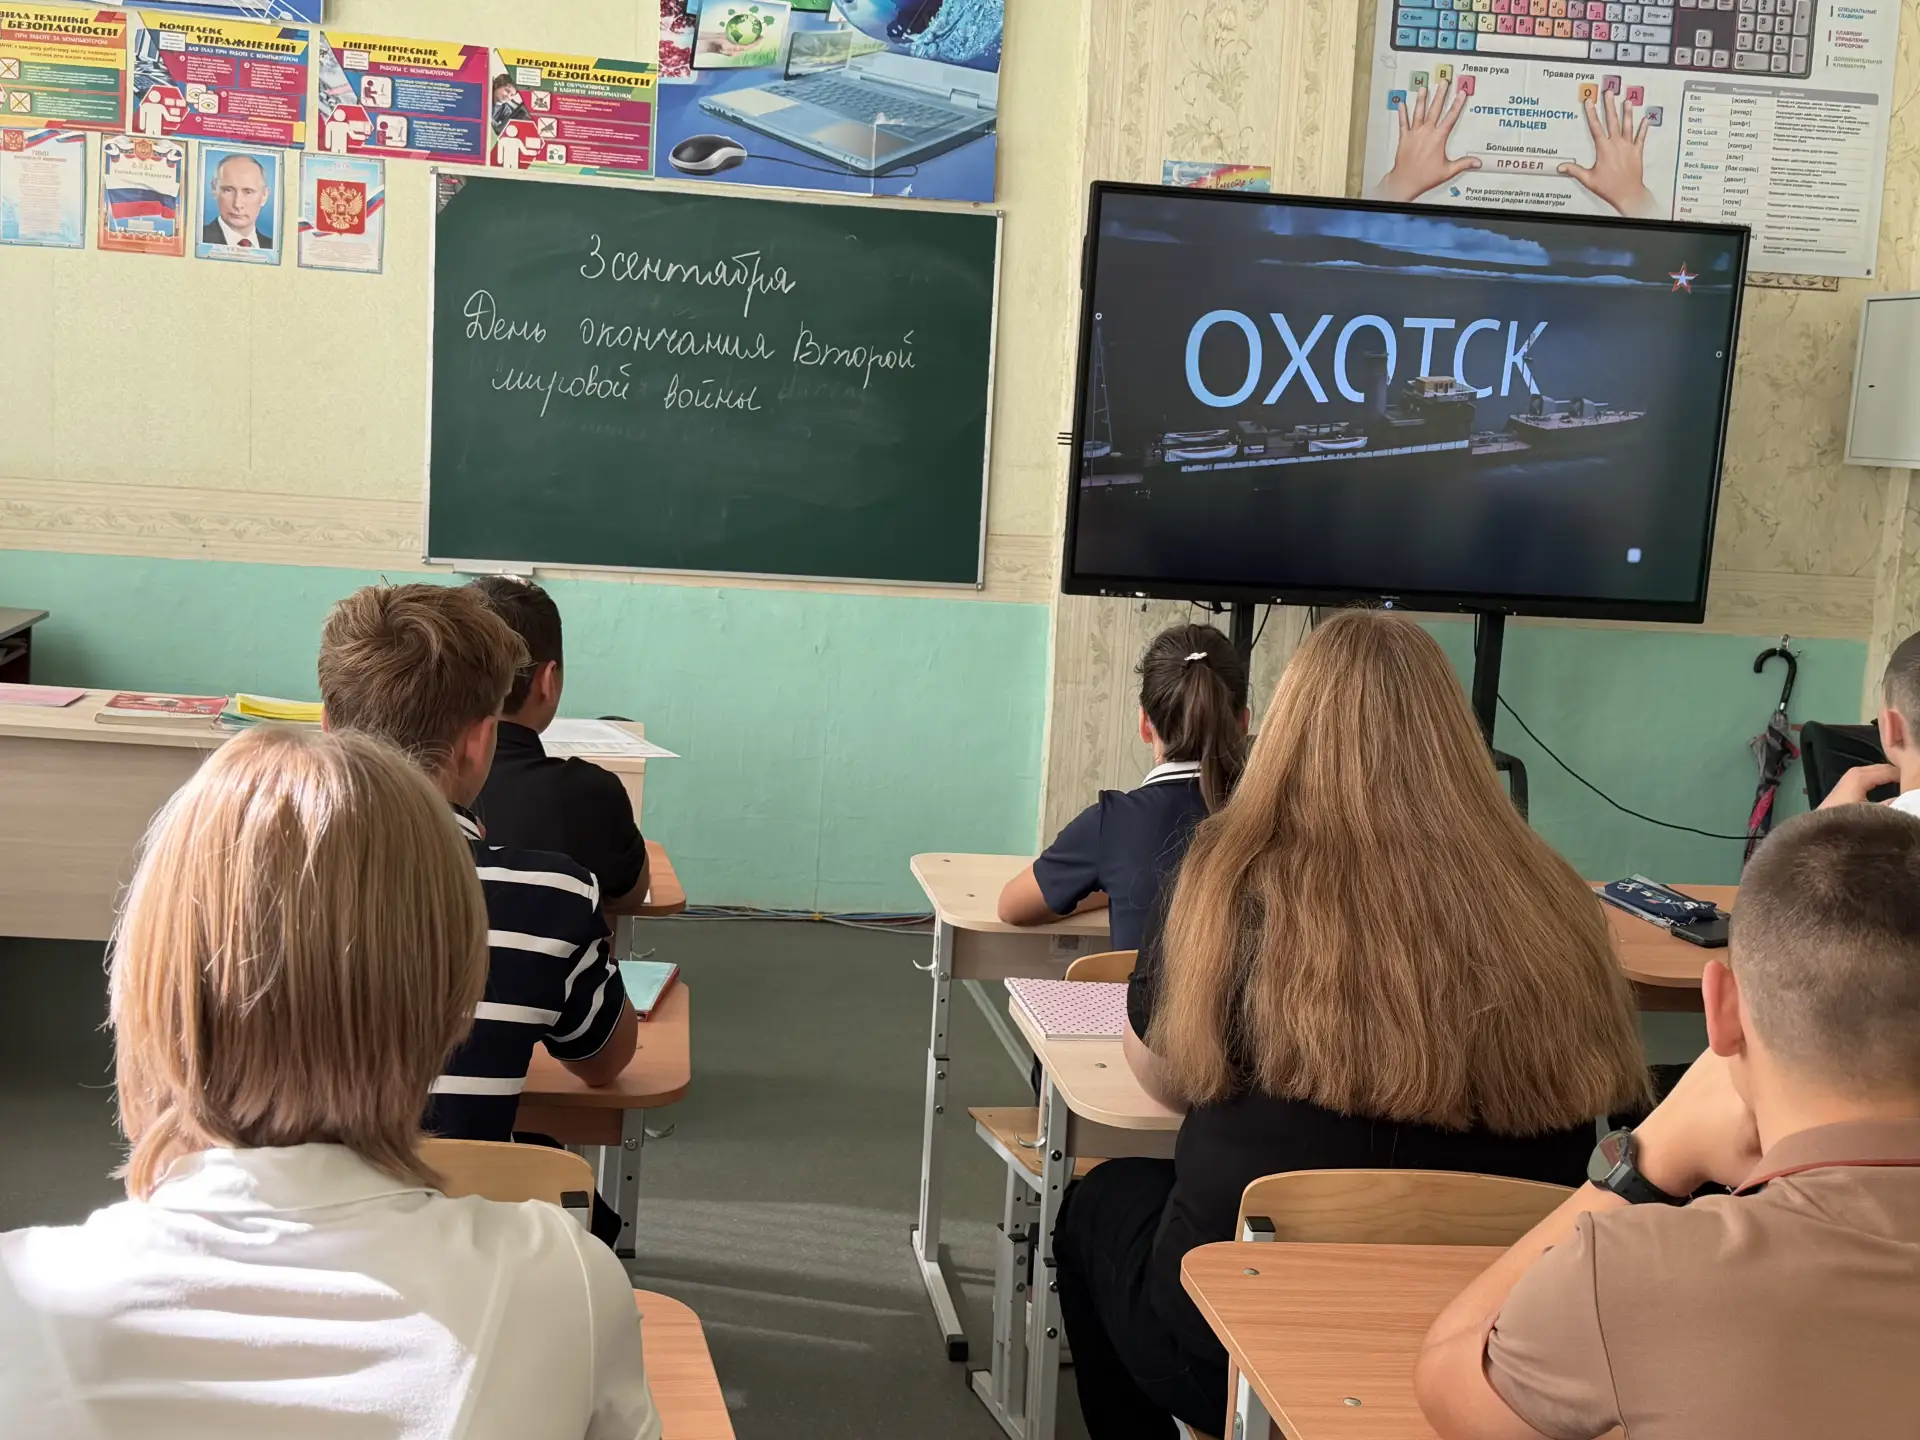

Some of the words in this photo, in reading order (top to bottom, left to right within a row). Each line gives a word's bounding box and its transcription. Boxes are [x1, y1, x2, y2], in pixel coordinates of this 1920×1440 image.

[34, 13, 89, 24] ТЕХНИКИ
[8, 20, 119, 36] БЕЗОПАСНОСТИ
[159, 22, 223, 35] КОМПЛЕКС
[196, 34, 296, 53] УПРАЖНЕНИЙ
[343, 41, 439, 56] ГИГИЕНИЧЕСКИЕ
[387, 54, 448, 66] ПРАВИЛА
[516, 57, 590, 71] ТРЕБОВАНИЯ
[1440, 70, 1446, 78] В
[1462, 64, 1488, 72] Левая
[1490, 66, 1510, 75] рука
[1543, 69, 1574, 79] Правая
[1575, 72, 1595, 80] рука
[548, 70, 651, 86] БЕЗОПАСНОСТИ
[1462, 81, 1469, 90] А
[1584, 89, 1592, 97] О
[1630, 91, 1638, 100] Д
[1508, 95, 1539, 105] ЗОНЫ
[1469, 106, 1579, 119] «ОТВЕТСТВЕННОСТИ»
[1499, 119, 1547, 130] ПАЛЬЦЕВ
[1486, 143, 1524, 153] Большие
[1526, 147, 1558, 155] пальцы
[1496, 159, 1544, 170] ПРОБЕЛ
[1466, 187, 1482, 195] Руки
[1484, 189, 1530, 197] располагайте
[580, 234, 605, 279] 3
[611, 250, 796, 318] сентября
[463, 289, 547, 343] День
[579, 318, 775, 359] окончания
[793, 320, 916, 389] Второй
[1184, 308, 1548, 407] ОХОТСК
[492, 363, 633, 417] мировой
[664, 373, 762, 411] войны
